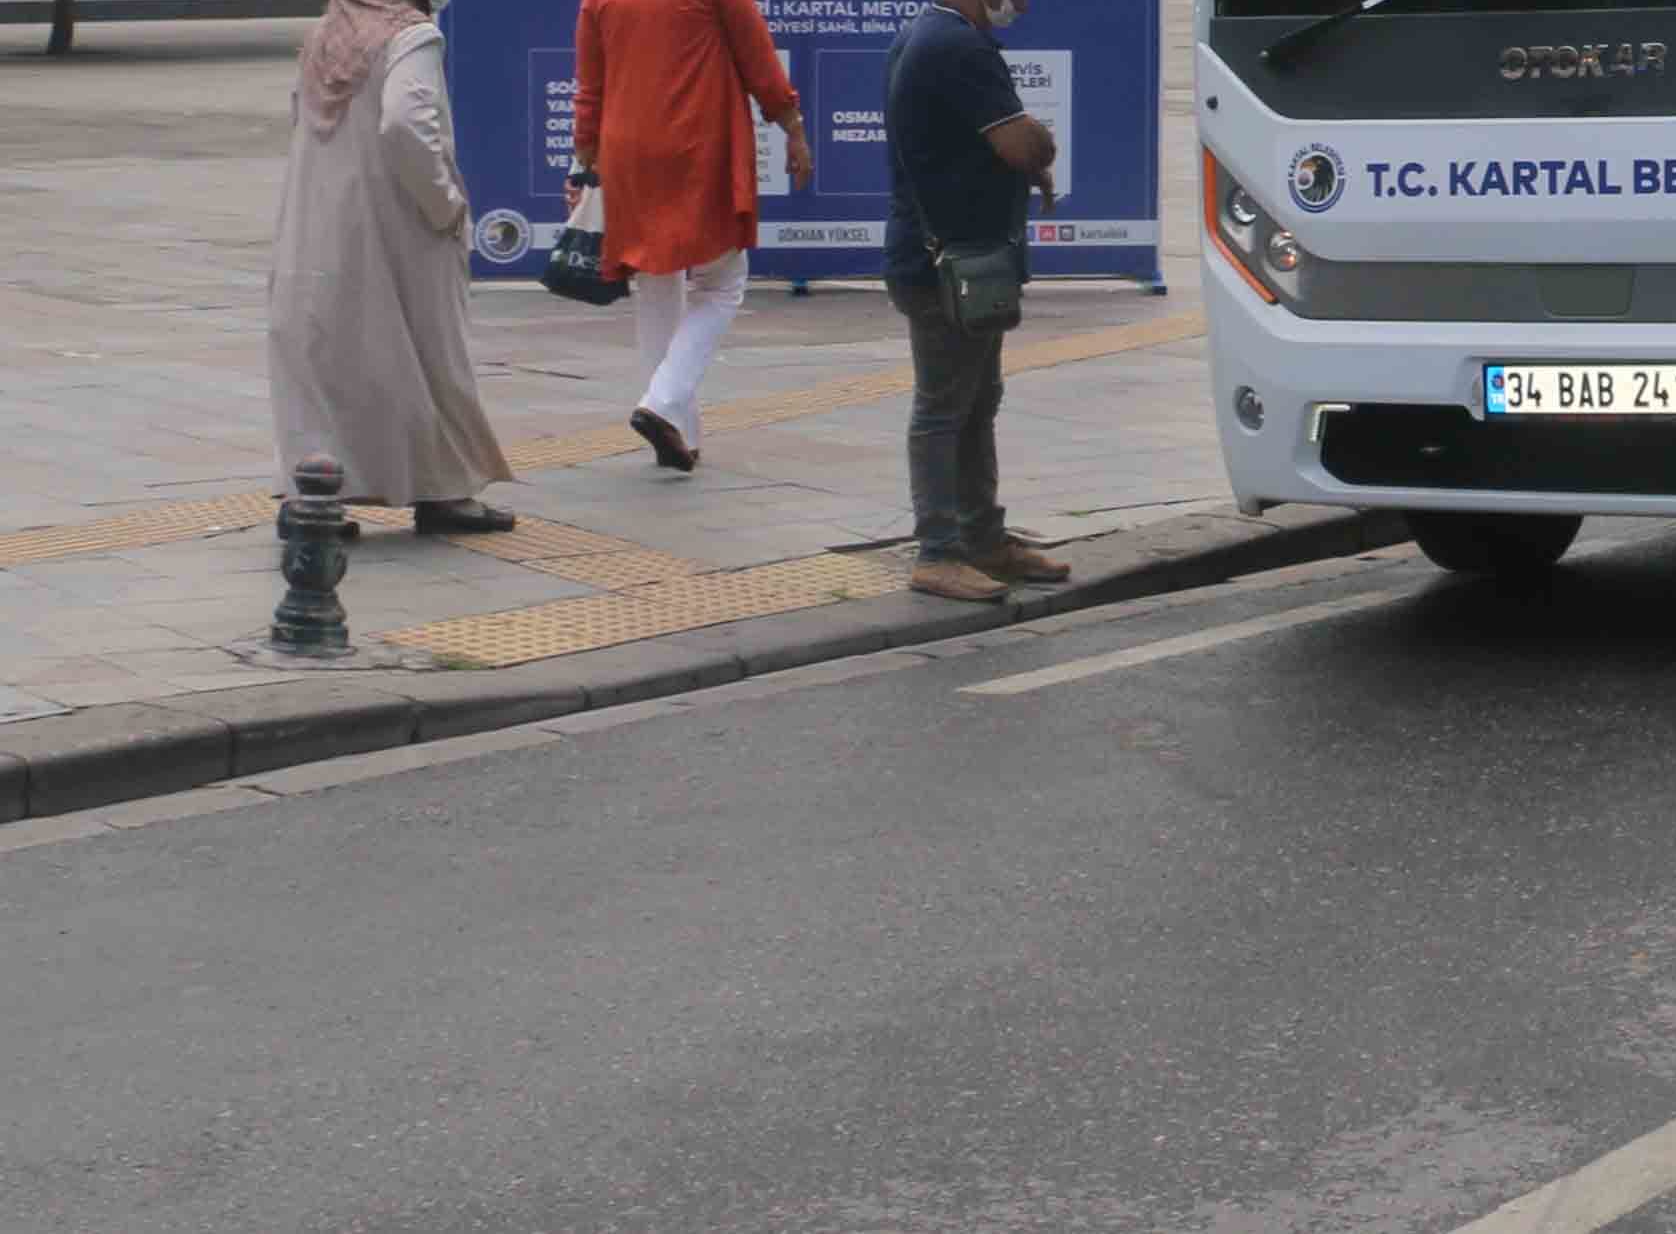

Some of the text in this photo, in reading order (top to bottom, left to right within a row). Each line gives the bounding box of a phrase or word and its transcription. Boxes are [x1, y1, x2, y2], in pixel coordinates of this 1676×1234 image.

[784, 1, 857, 17] KARTAL
[768, 17, 814, 33] DİYESİ
[1501, 42, 1667, 80] OTOKAR
[832, 111, 884, 124] OSMA
[832, 129, 888, 142] MEZAR
[1366, 162, 1437, 197] T.C.
[1449, 160, 1621, 197] KARTAL
[778, 226, 872, 242] GÖKHAN YÜKSEL
[1508, 372, 1542, 407] 34
[1559, 372, 1614, 407] BAB
